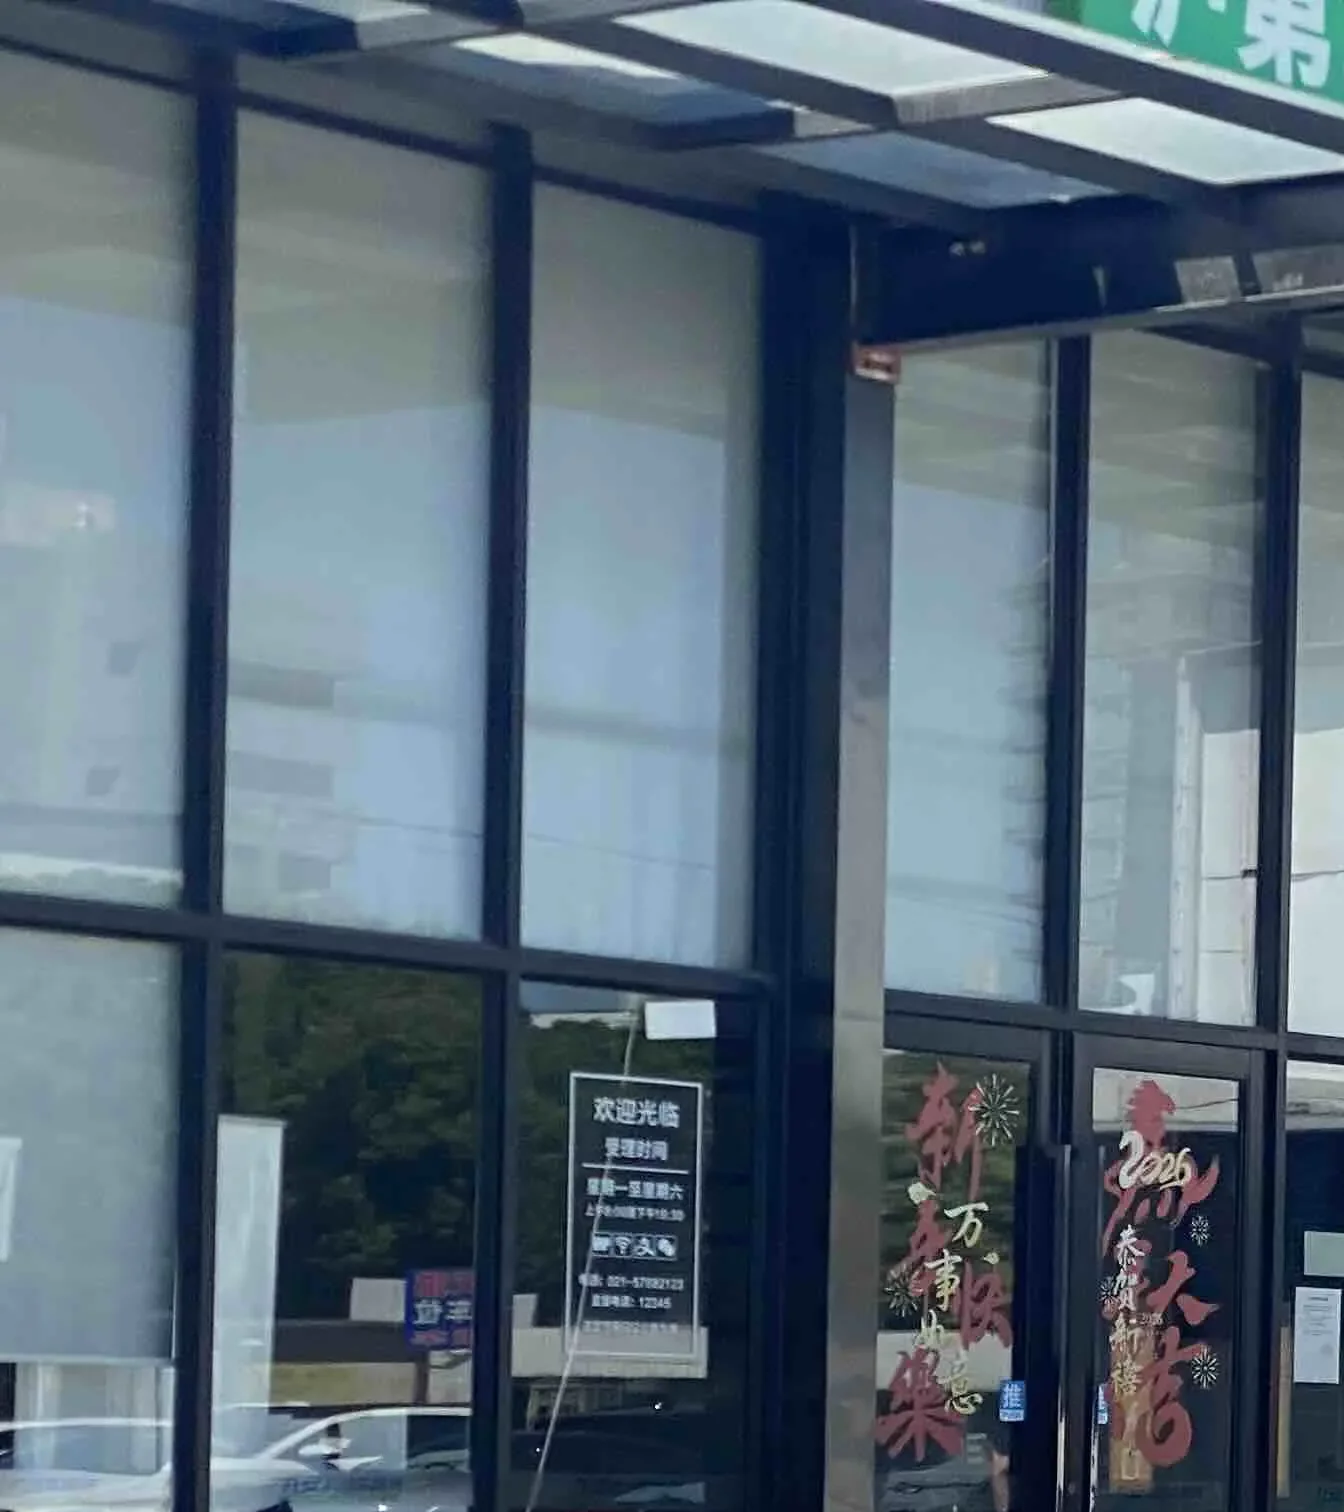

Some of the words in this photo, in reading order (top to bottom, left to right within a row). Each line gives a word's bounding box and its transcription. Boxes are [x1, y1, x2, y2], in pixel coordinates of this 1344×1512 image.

[592, 1097, 680, 1128] 欢迎光临
[1118, 1130, 1192, 1191] 2026
